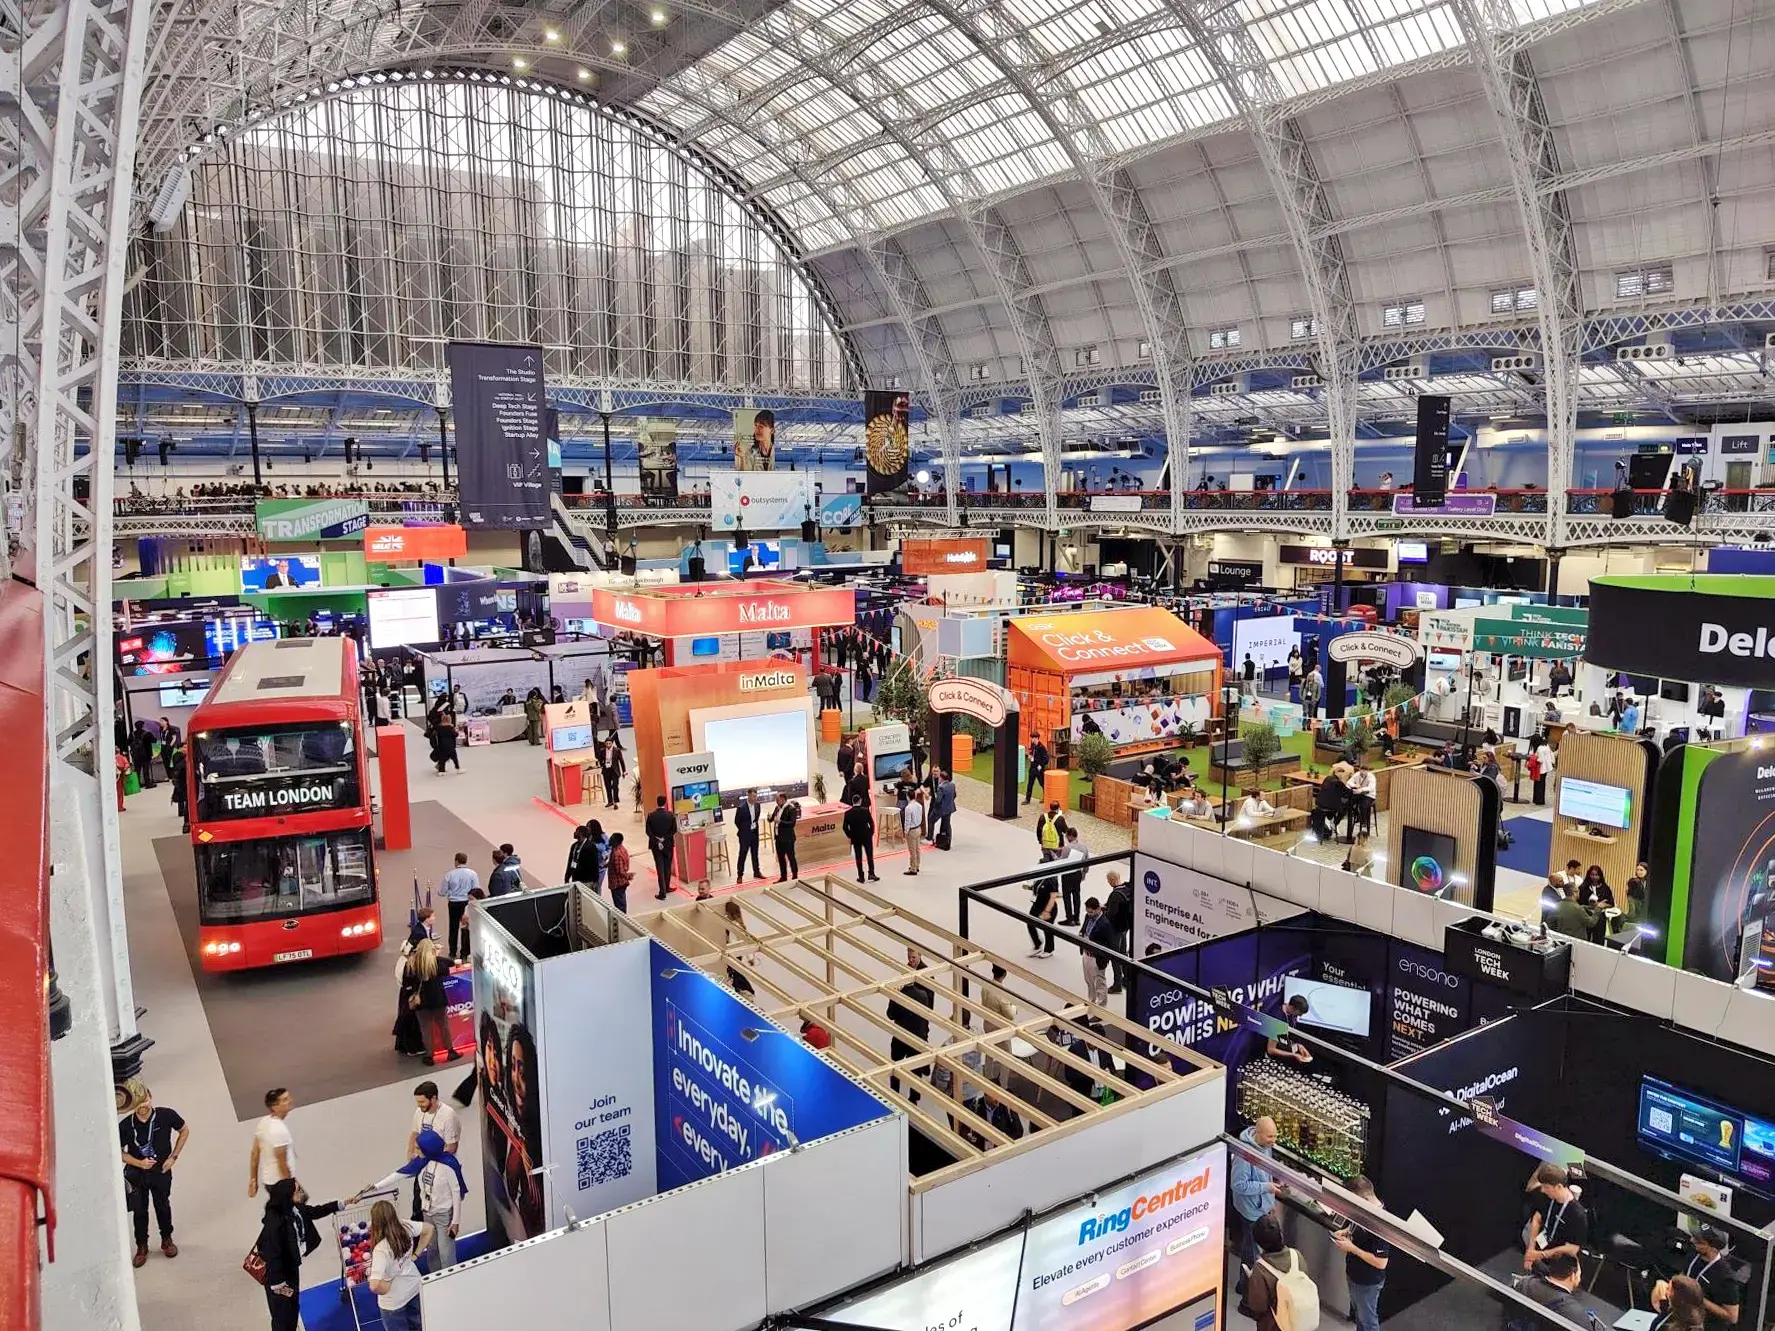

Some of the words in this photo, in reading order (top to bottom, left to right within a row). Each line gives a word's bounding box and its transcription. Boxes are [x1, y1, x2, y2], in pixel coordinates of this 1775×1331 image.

[478, 374, 519, 382] Transformation
[1731, 440, 1748, 449] Lift
[261, 502, 367, 538] TRANSFORMATION
[821, 503, 852, 525] CORE
[342, 516, 368, 534] STAGE
[1220, 564, 1252, 578] Lounge
[615, 599, 643, 623] Malta
[739, 601, 791, 622] Malta
[1042, 633, 1094, 648] Click
[1093, 630, 1117, 643] &
[1439, 626, 1468, 634] PAKISTAN
[1520, 629, 1550, 638] THINK
[1058, 642, 1150, 661] Connect
[1249, 638, 1286, 649] IMPERIAL
[1340, 643, 1359, 653] Click
[1361, 642, 1367, 650] &
[1368, 643, 1402, 658] Connect
[1541, 641, 1585, 652] PAKISTA
[741, 672, 795, 689] inMalta
[939, 692, 957, 701] Click
[957, 691, 962, 699] &
[963, 692, 993, 713] Connect
[224, 792, 266, 809] TEAM
[269, 785, 333, 805] LONDON
[812, 823, 836, 834] Malta
[1145, 895, 1190, 920] Enterprise
[1192, 911, 1205, 925] AI.
[1145, 908, 1195, 936] Engineered
[1197, 927, 1210, 940] for
[1474, 953, 1501, 969] TECH
[1475, 947, 1501, 960] LONDON
[1323, 962, 1345, 977] Your
[1400, 959, 1460, 988] ensono
[1481, 963, 1510, 981] WEEK
[1211, 992, 1228, 1003] TECH
[1216, 999, 1231, 1010] WEEK
[1394, 987, 1458, 1018] POWERING
[1394, 999, 1430, 1018] WHAT
[1392, 1020, 1426, 1042] NEXT.
[1393, 1012, 1435, 1034] COMES
[678, 1019, 751, 1104] Innovate
[754, 1083, 789, 1135] the
[1456, 1067, 1518, 1102] DigitalOcean
[589, 1094, 616, 1110] Join
[1472, 1098, 1492, 1110] LONDON
[1472, 1103, 1493, 1117] TECH
[575, 1116, 597, 1130] our
[600, 1107, 631, 1123] team
[672, 1067, 751, 1159] everyday,
[1476, 1112, 1499, 1127] WEEK
[683, 1121, 729, 1175] every
[1078, 1167, 1210, 1246] RingCentral
[1032, 1264, 1074, 1290] Elevate
[1076, 1250, 1105, 1270] every
[1106, 1227, 1155, 1256] customer
[1156, 1201, 1210, 1233] experience
[948, 1310, 963, 1328] of
